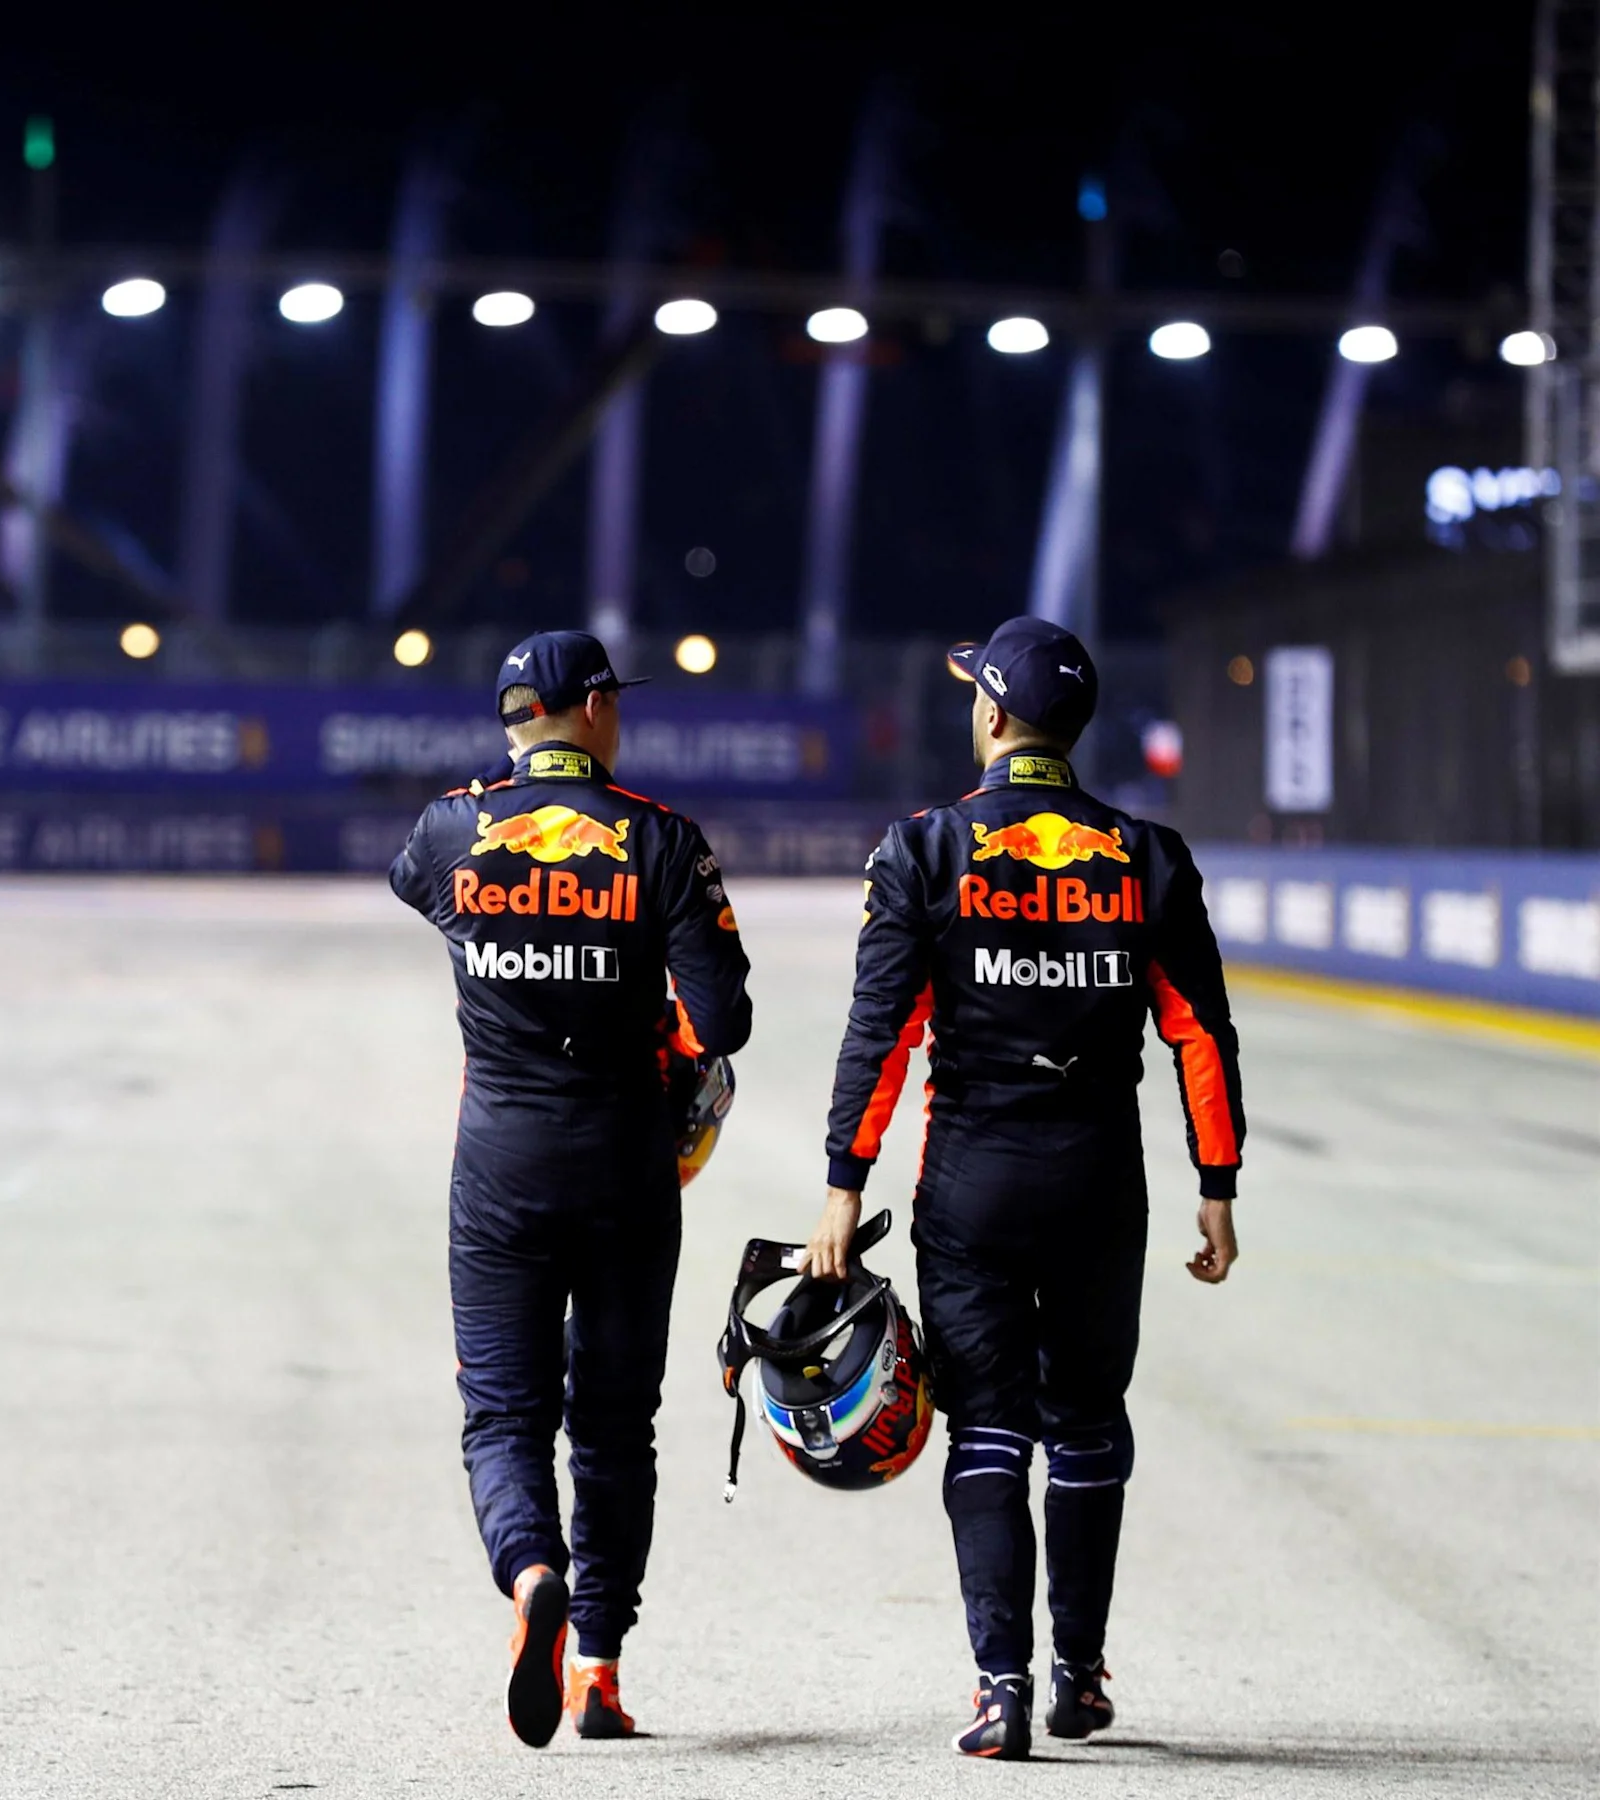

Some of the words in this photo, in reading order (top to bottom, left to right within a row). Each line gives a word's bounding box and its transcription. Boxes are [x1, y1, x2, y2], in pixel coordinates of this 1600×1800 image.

[14, 709, 238, 771] AIRLINES
[454, 867, 541, 915] Red
[548, 870, 638, 922] Bull
[959, 874, 1049, 922] Red
[1056, 876, 1144, 923] Bull
[464, 941, 574, 980] Mobil
[975, 948, 1088, 988] Mobil
[862, 1390, 913, 1456] Bull
